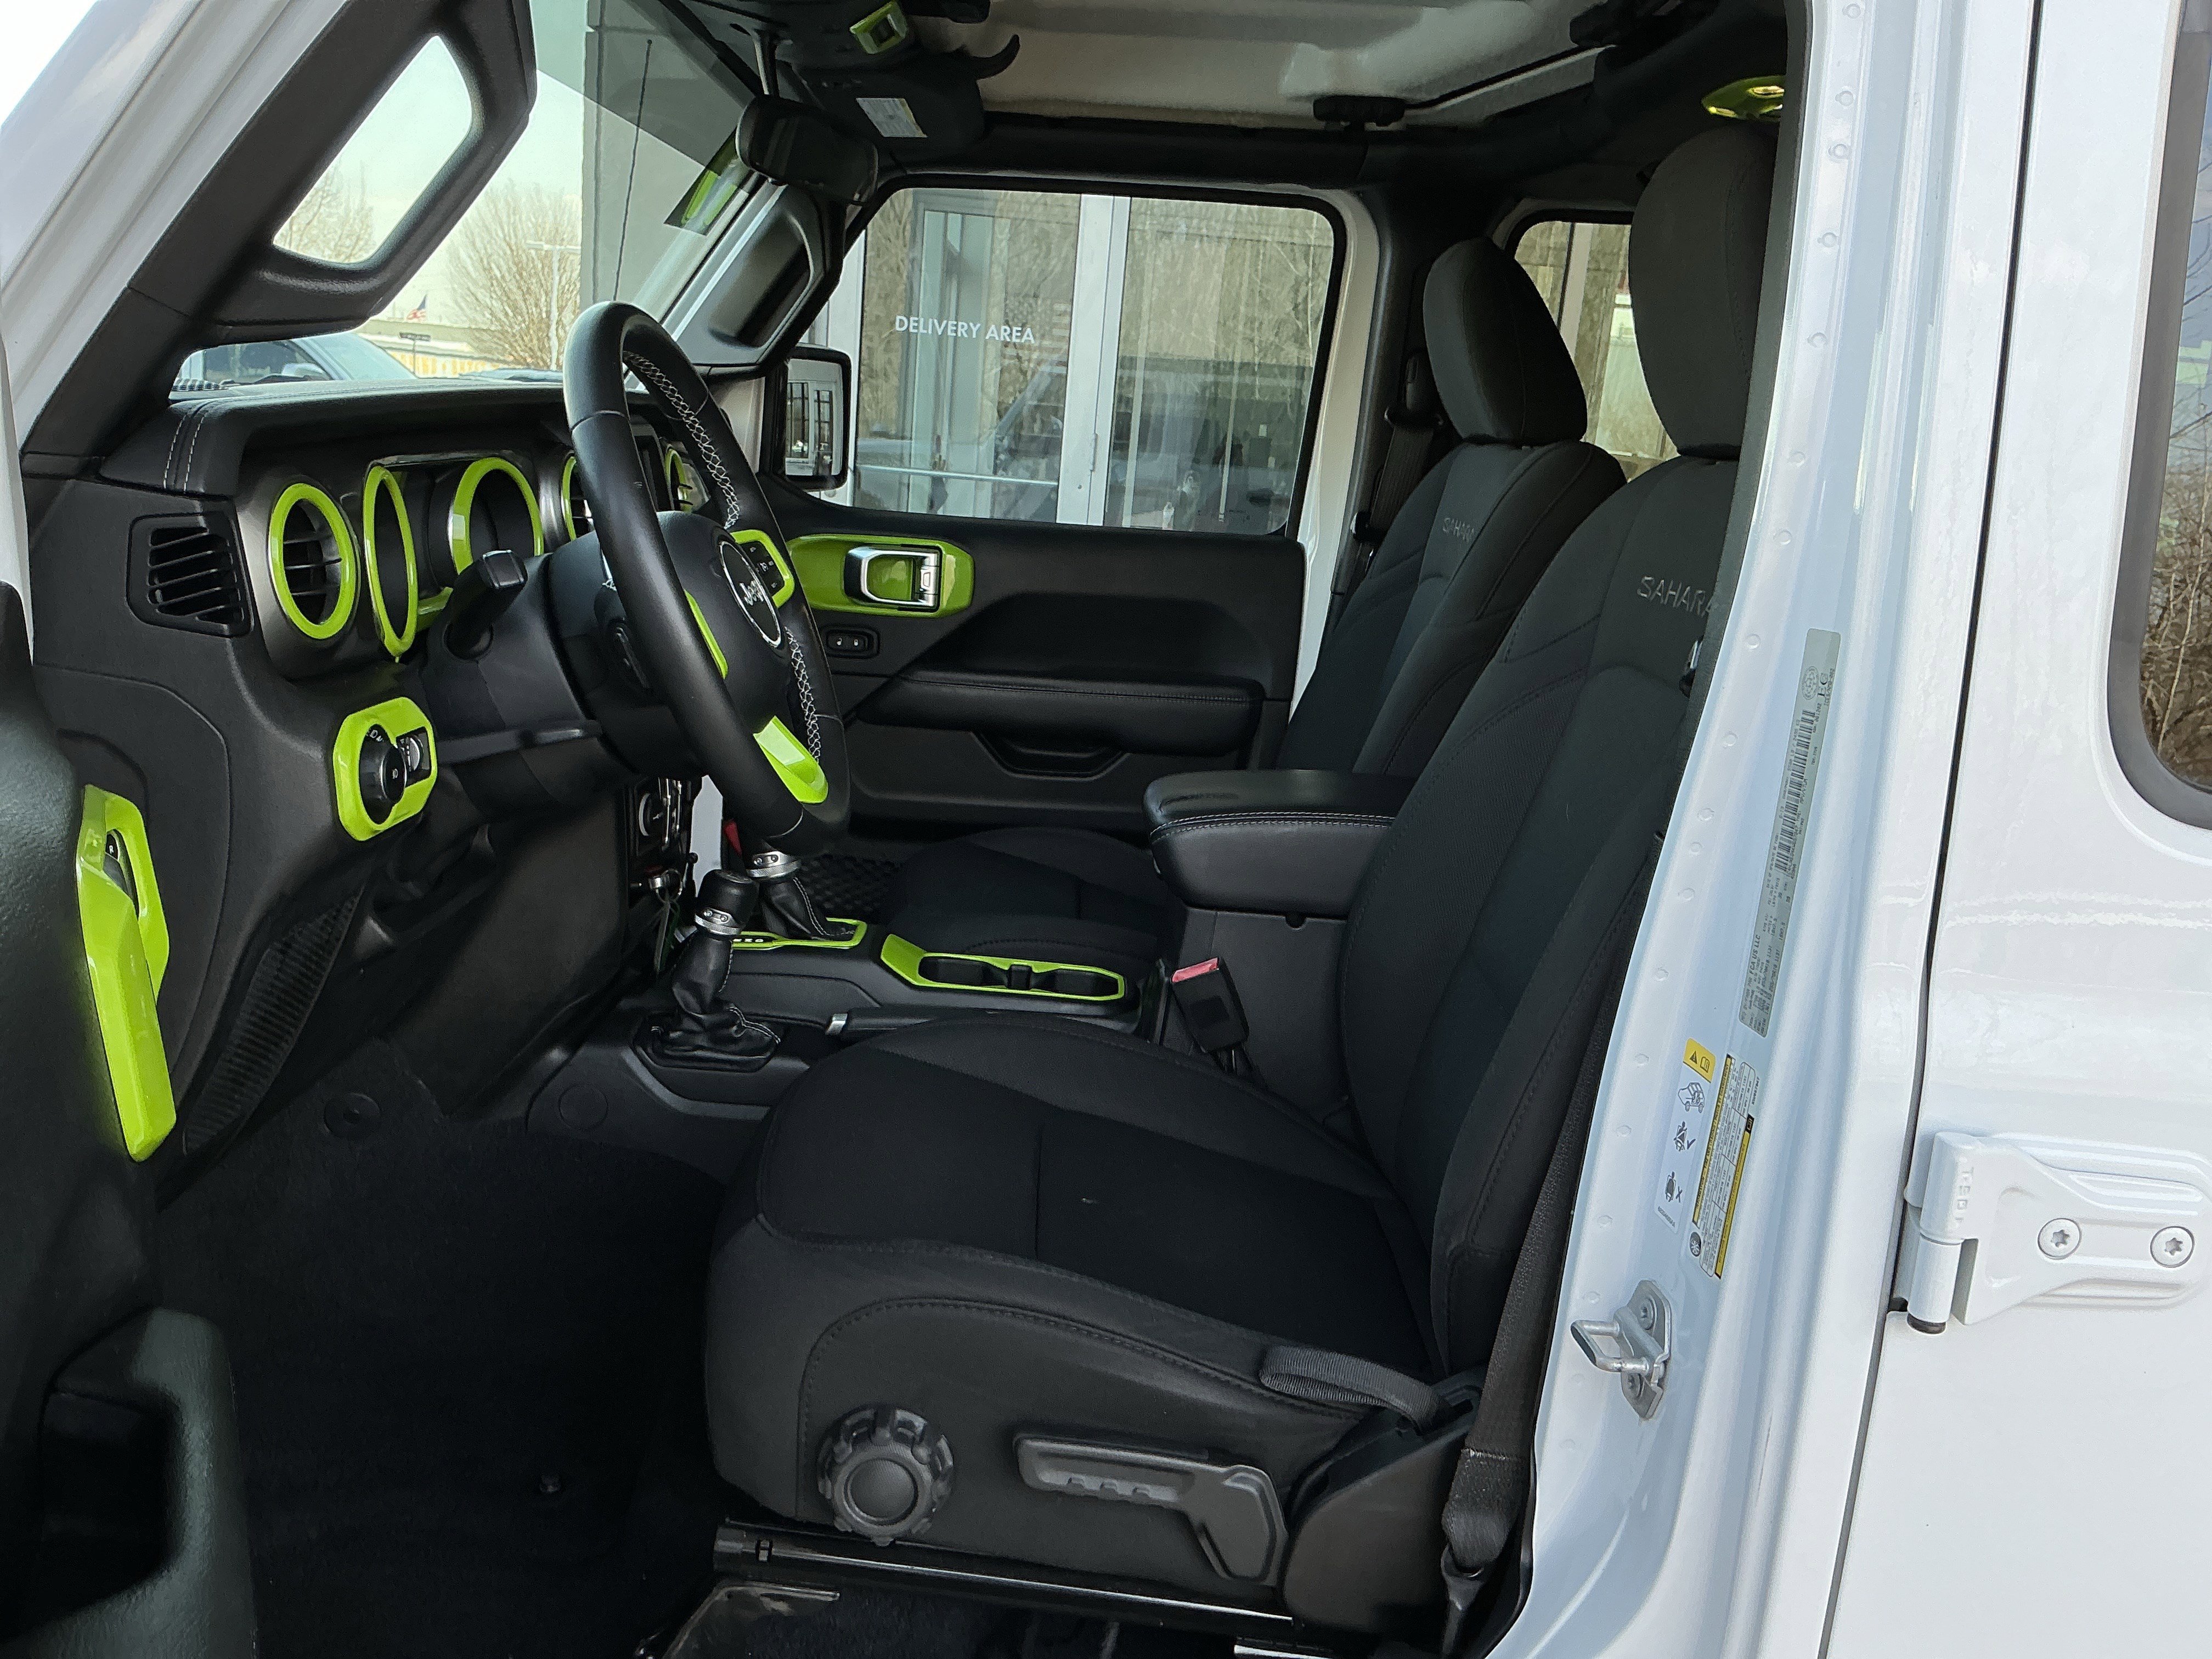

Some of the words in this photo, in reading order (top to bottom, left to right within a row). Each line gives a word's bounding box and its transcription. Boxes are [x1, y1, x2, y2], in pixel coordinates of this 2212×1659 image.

[895, 315, 981, 338] DELIVERY
[985, 324, 1035, 343] AREA
[1751, 947, 1758, 961] US
